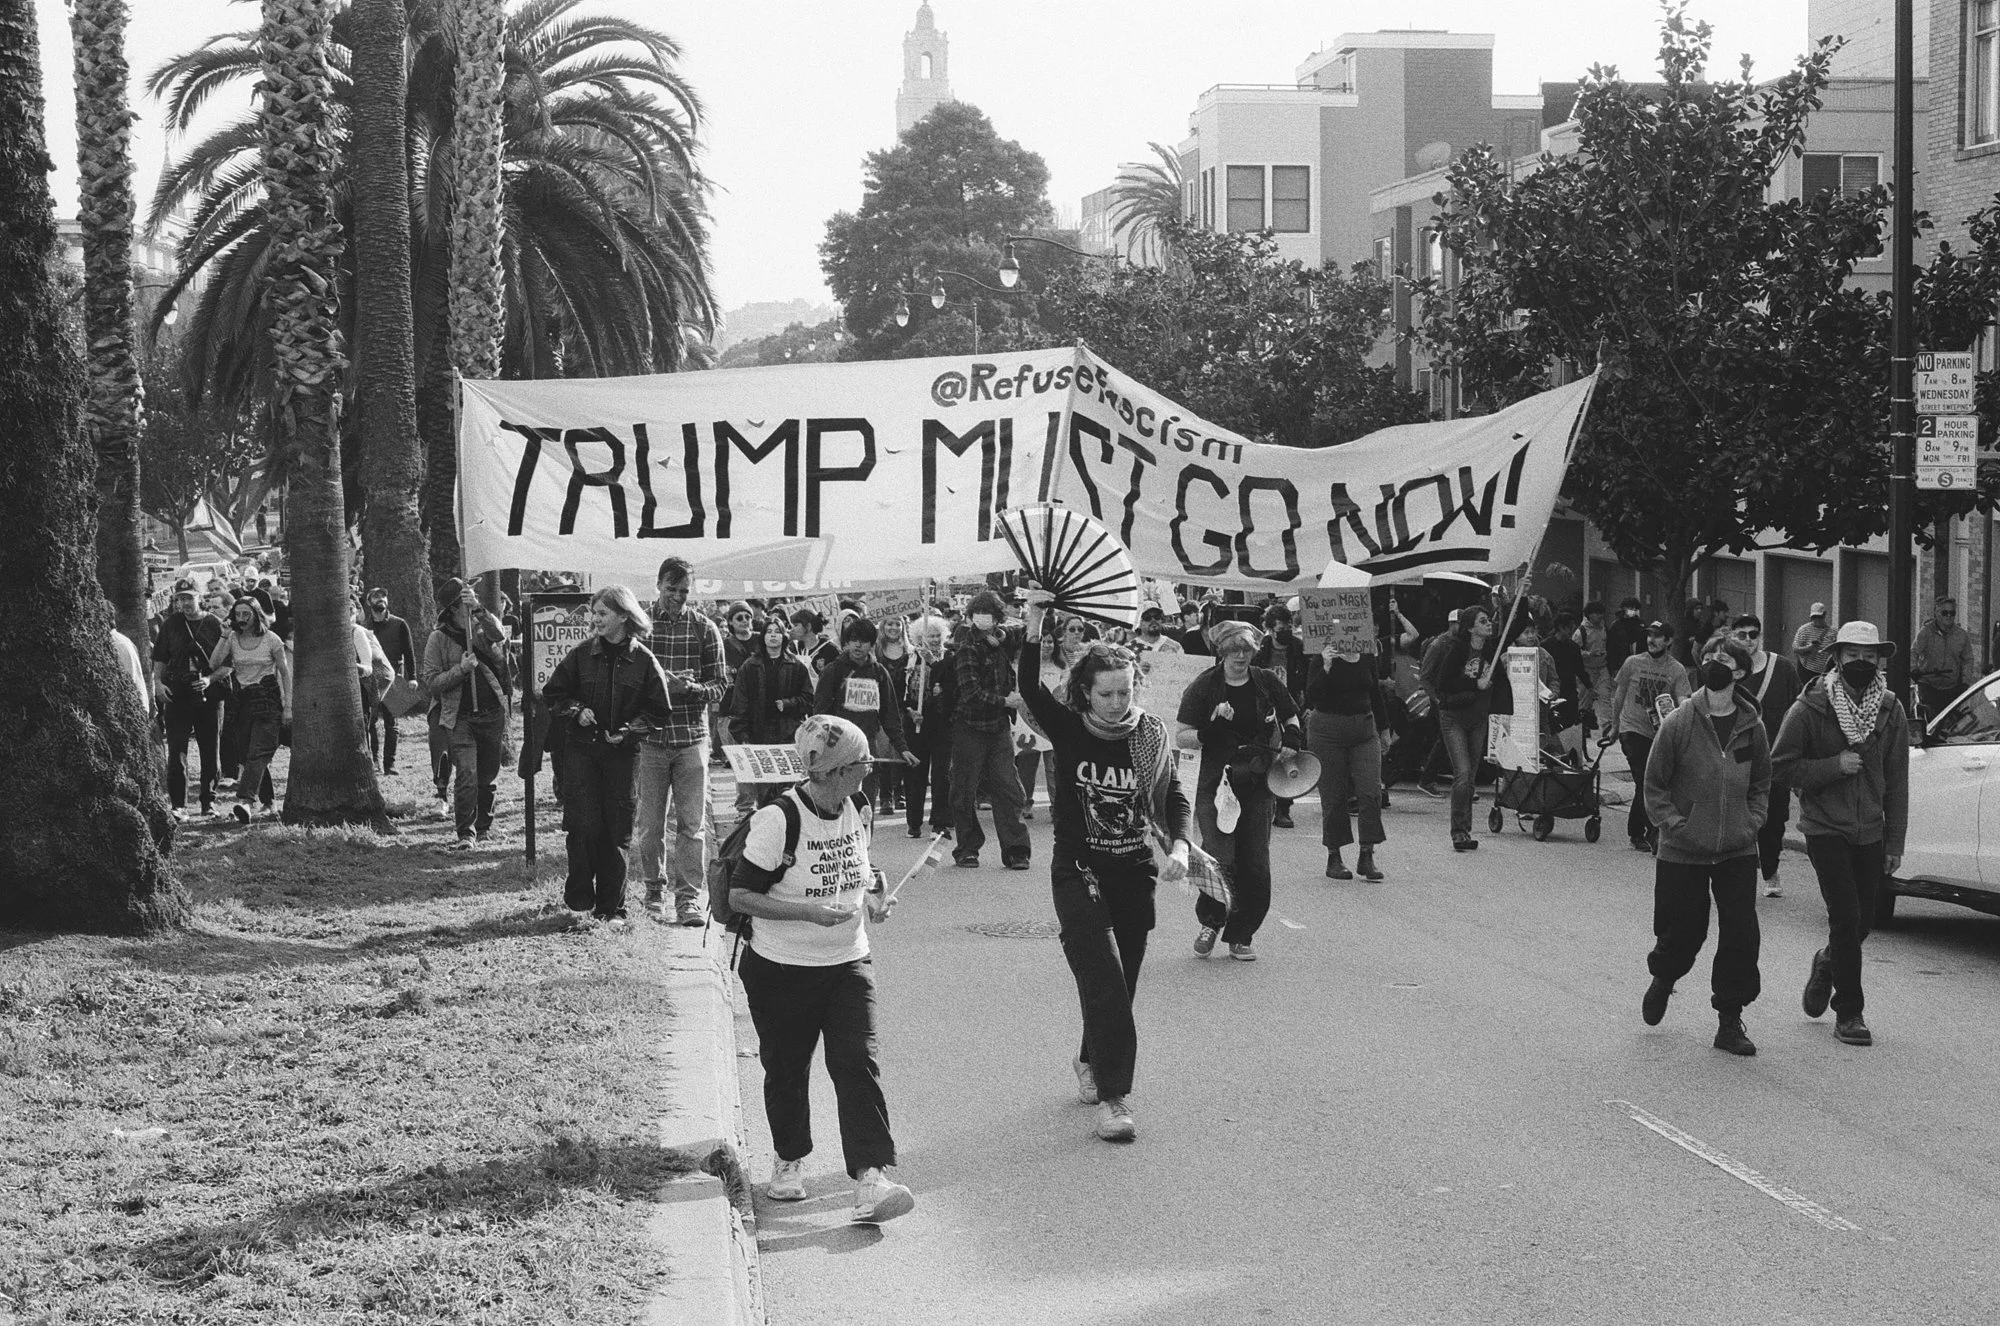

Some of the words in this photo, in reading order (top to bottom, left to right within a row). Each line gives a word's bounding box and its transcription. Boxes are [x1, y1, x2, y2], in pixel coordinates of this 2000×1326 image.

[1918, 354, 1933, 370] NO
[1936, 358, 1970, 369] PARKING
[1920, 390, 1969, 400] WEDNESDAY
[1922, 419, 1932, 434] 2
[1944, 420, 1968, 429] HOUR
[1923, 454, 1940, 462] MON
[1940, 474, 1950, 486] S
[499, 417, 877, 539] TRUMP
[1169, 463, 1302, 582] GO
[1327, 439, 1532, 564] NOW!
[1302, 596, 1320, 609] You
[1322, 598, 1336, 608] can
[1339, 594, 1368, 606] MASK
[1315, 611, 1328, 620] but
[534, 624, 555, 640] NO
[559, 628, 588, 640] PARK
[1308, 625, 1335, 636] HIDE
[1342, 626, 1361, 636] your
[548, 644, 572, 656] EXC
[822, 874, 839, 886] BUT
[844, 870, 860, 881] THE
[805, 881, 861, 897] PRESIDENT
